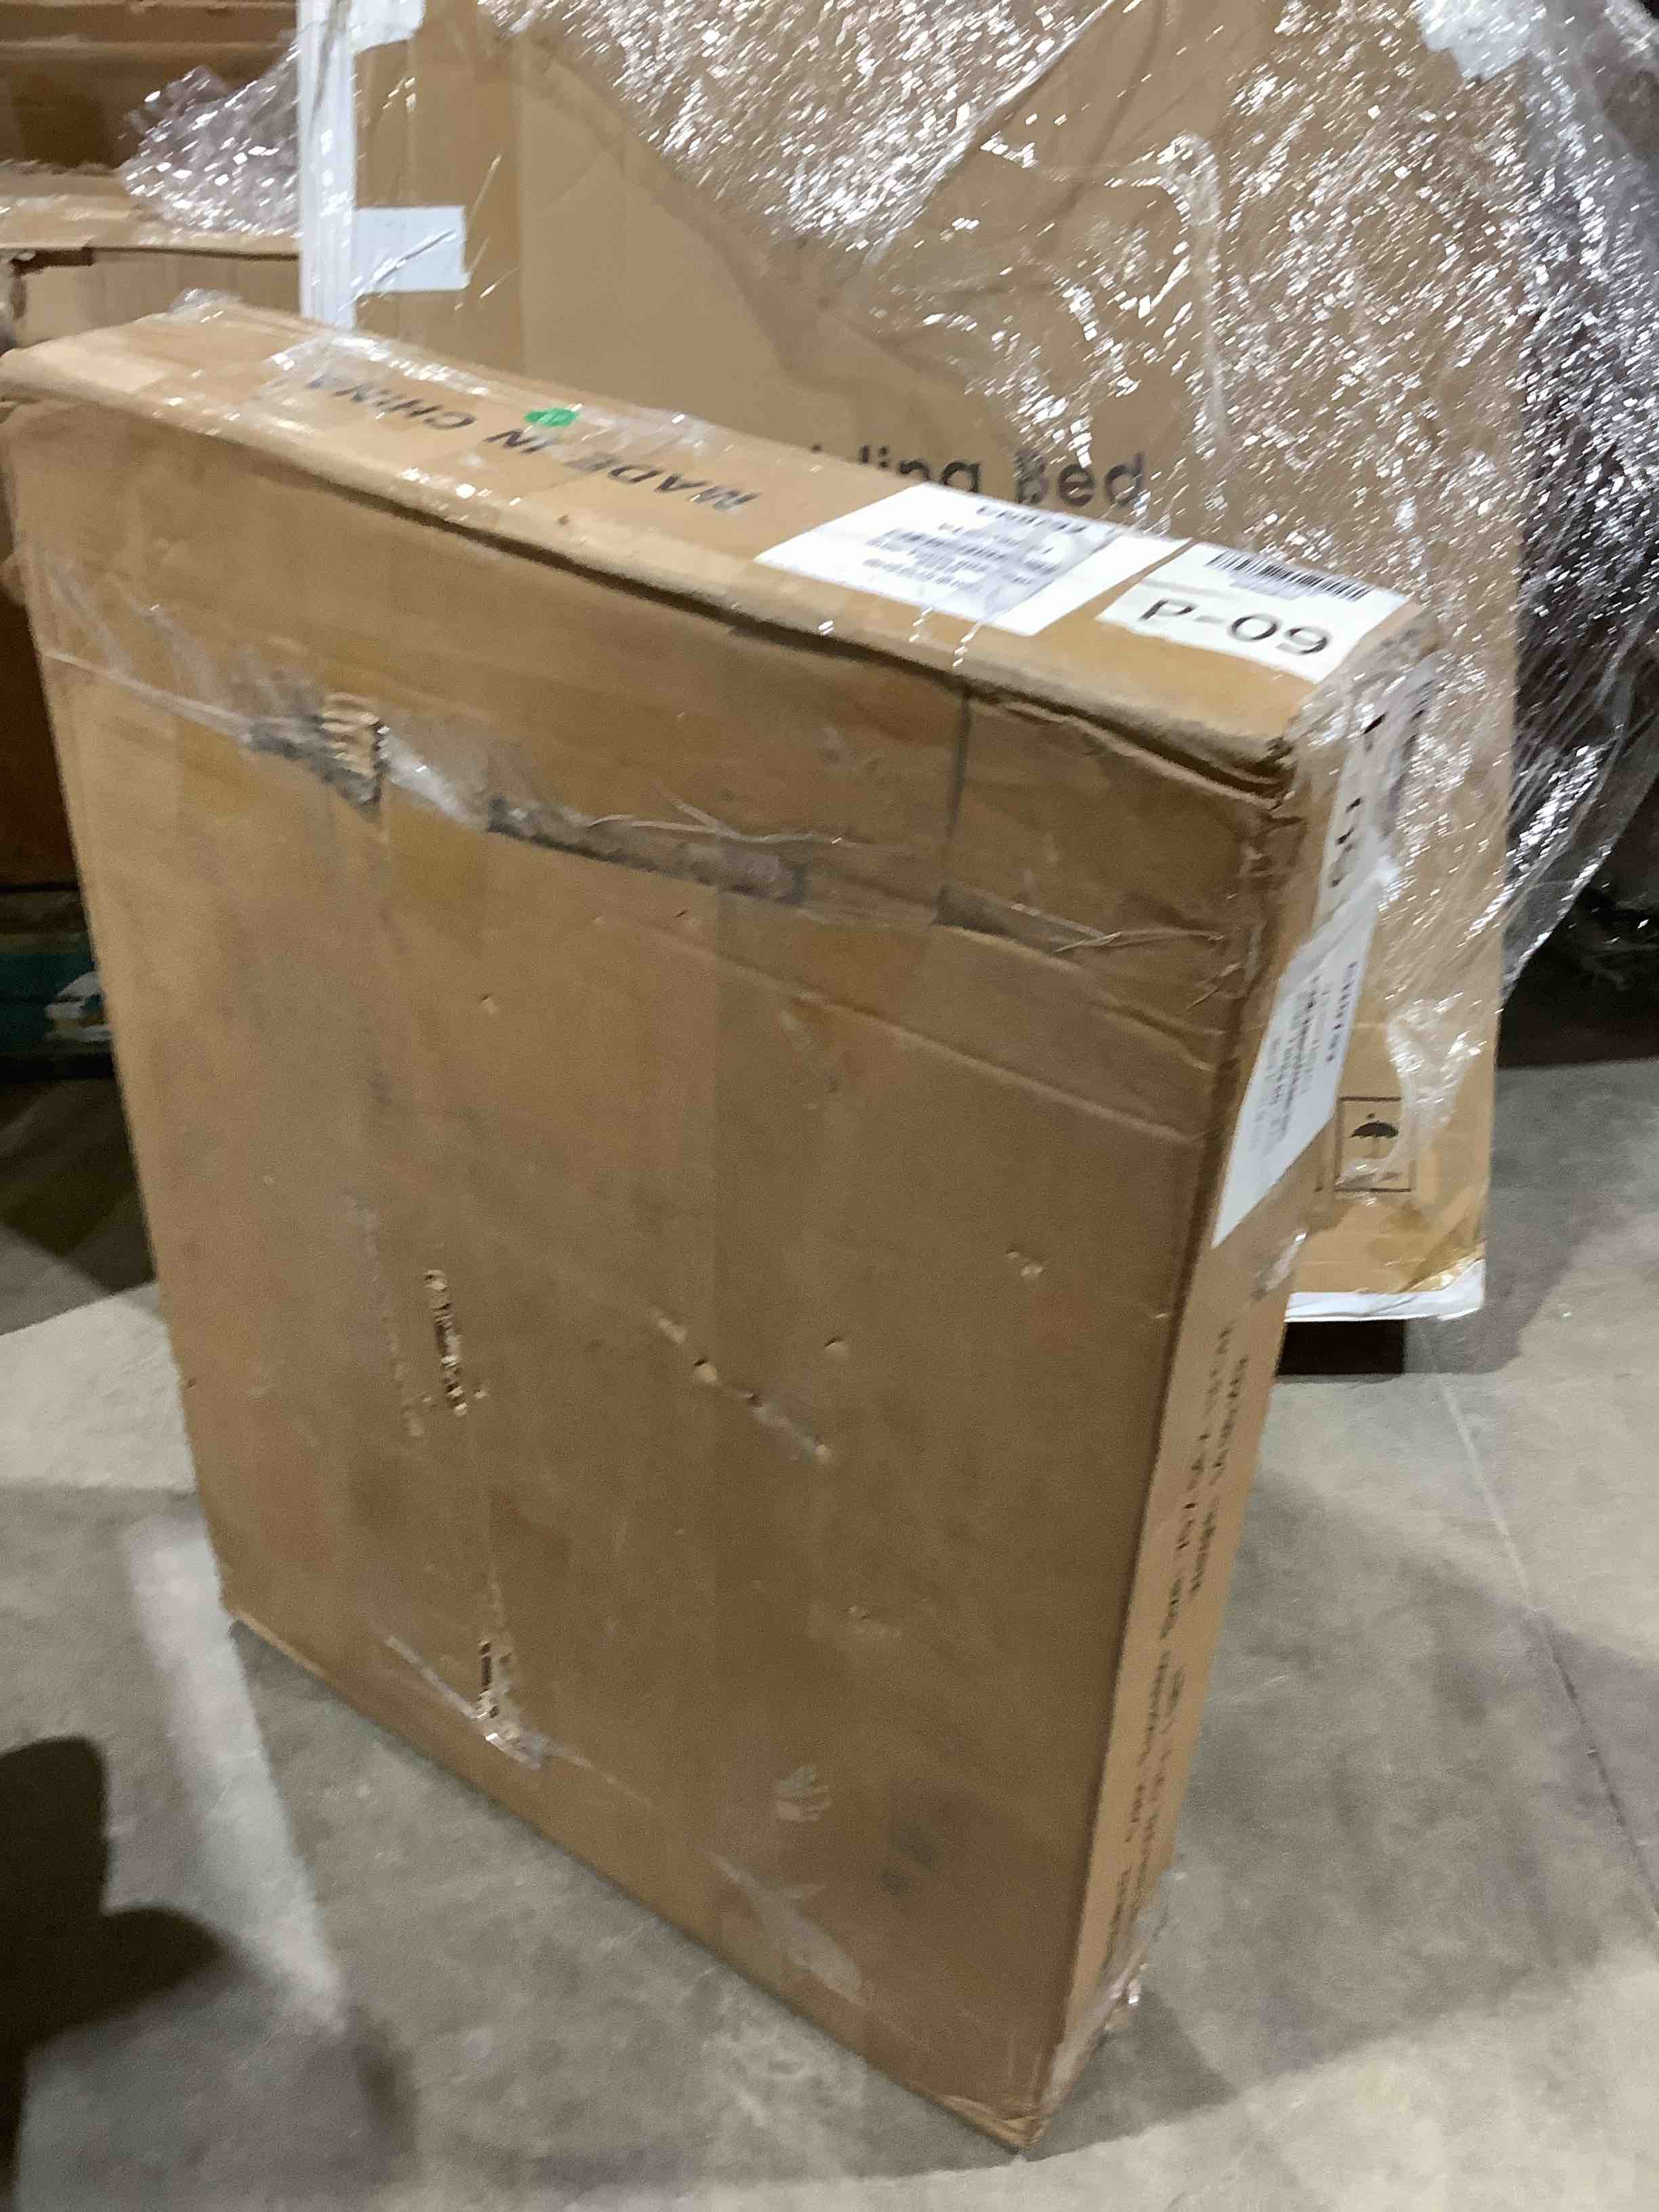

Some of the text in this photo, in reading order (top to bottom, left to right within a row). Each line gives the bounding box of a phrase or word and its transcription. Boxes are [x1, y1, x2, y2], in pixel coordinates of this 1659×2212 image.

[483, 428, 568, 455] IN
[560, 453, 762, 512] MADE
[1017, 450, 1145, 507] Bed
[1138, 598, 1332, 655] P-09
